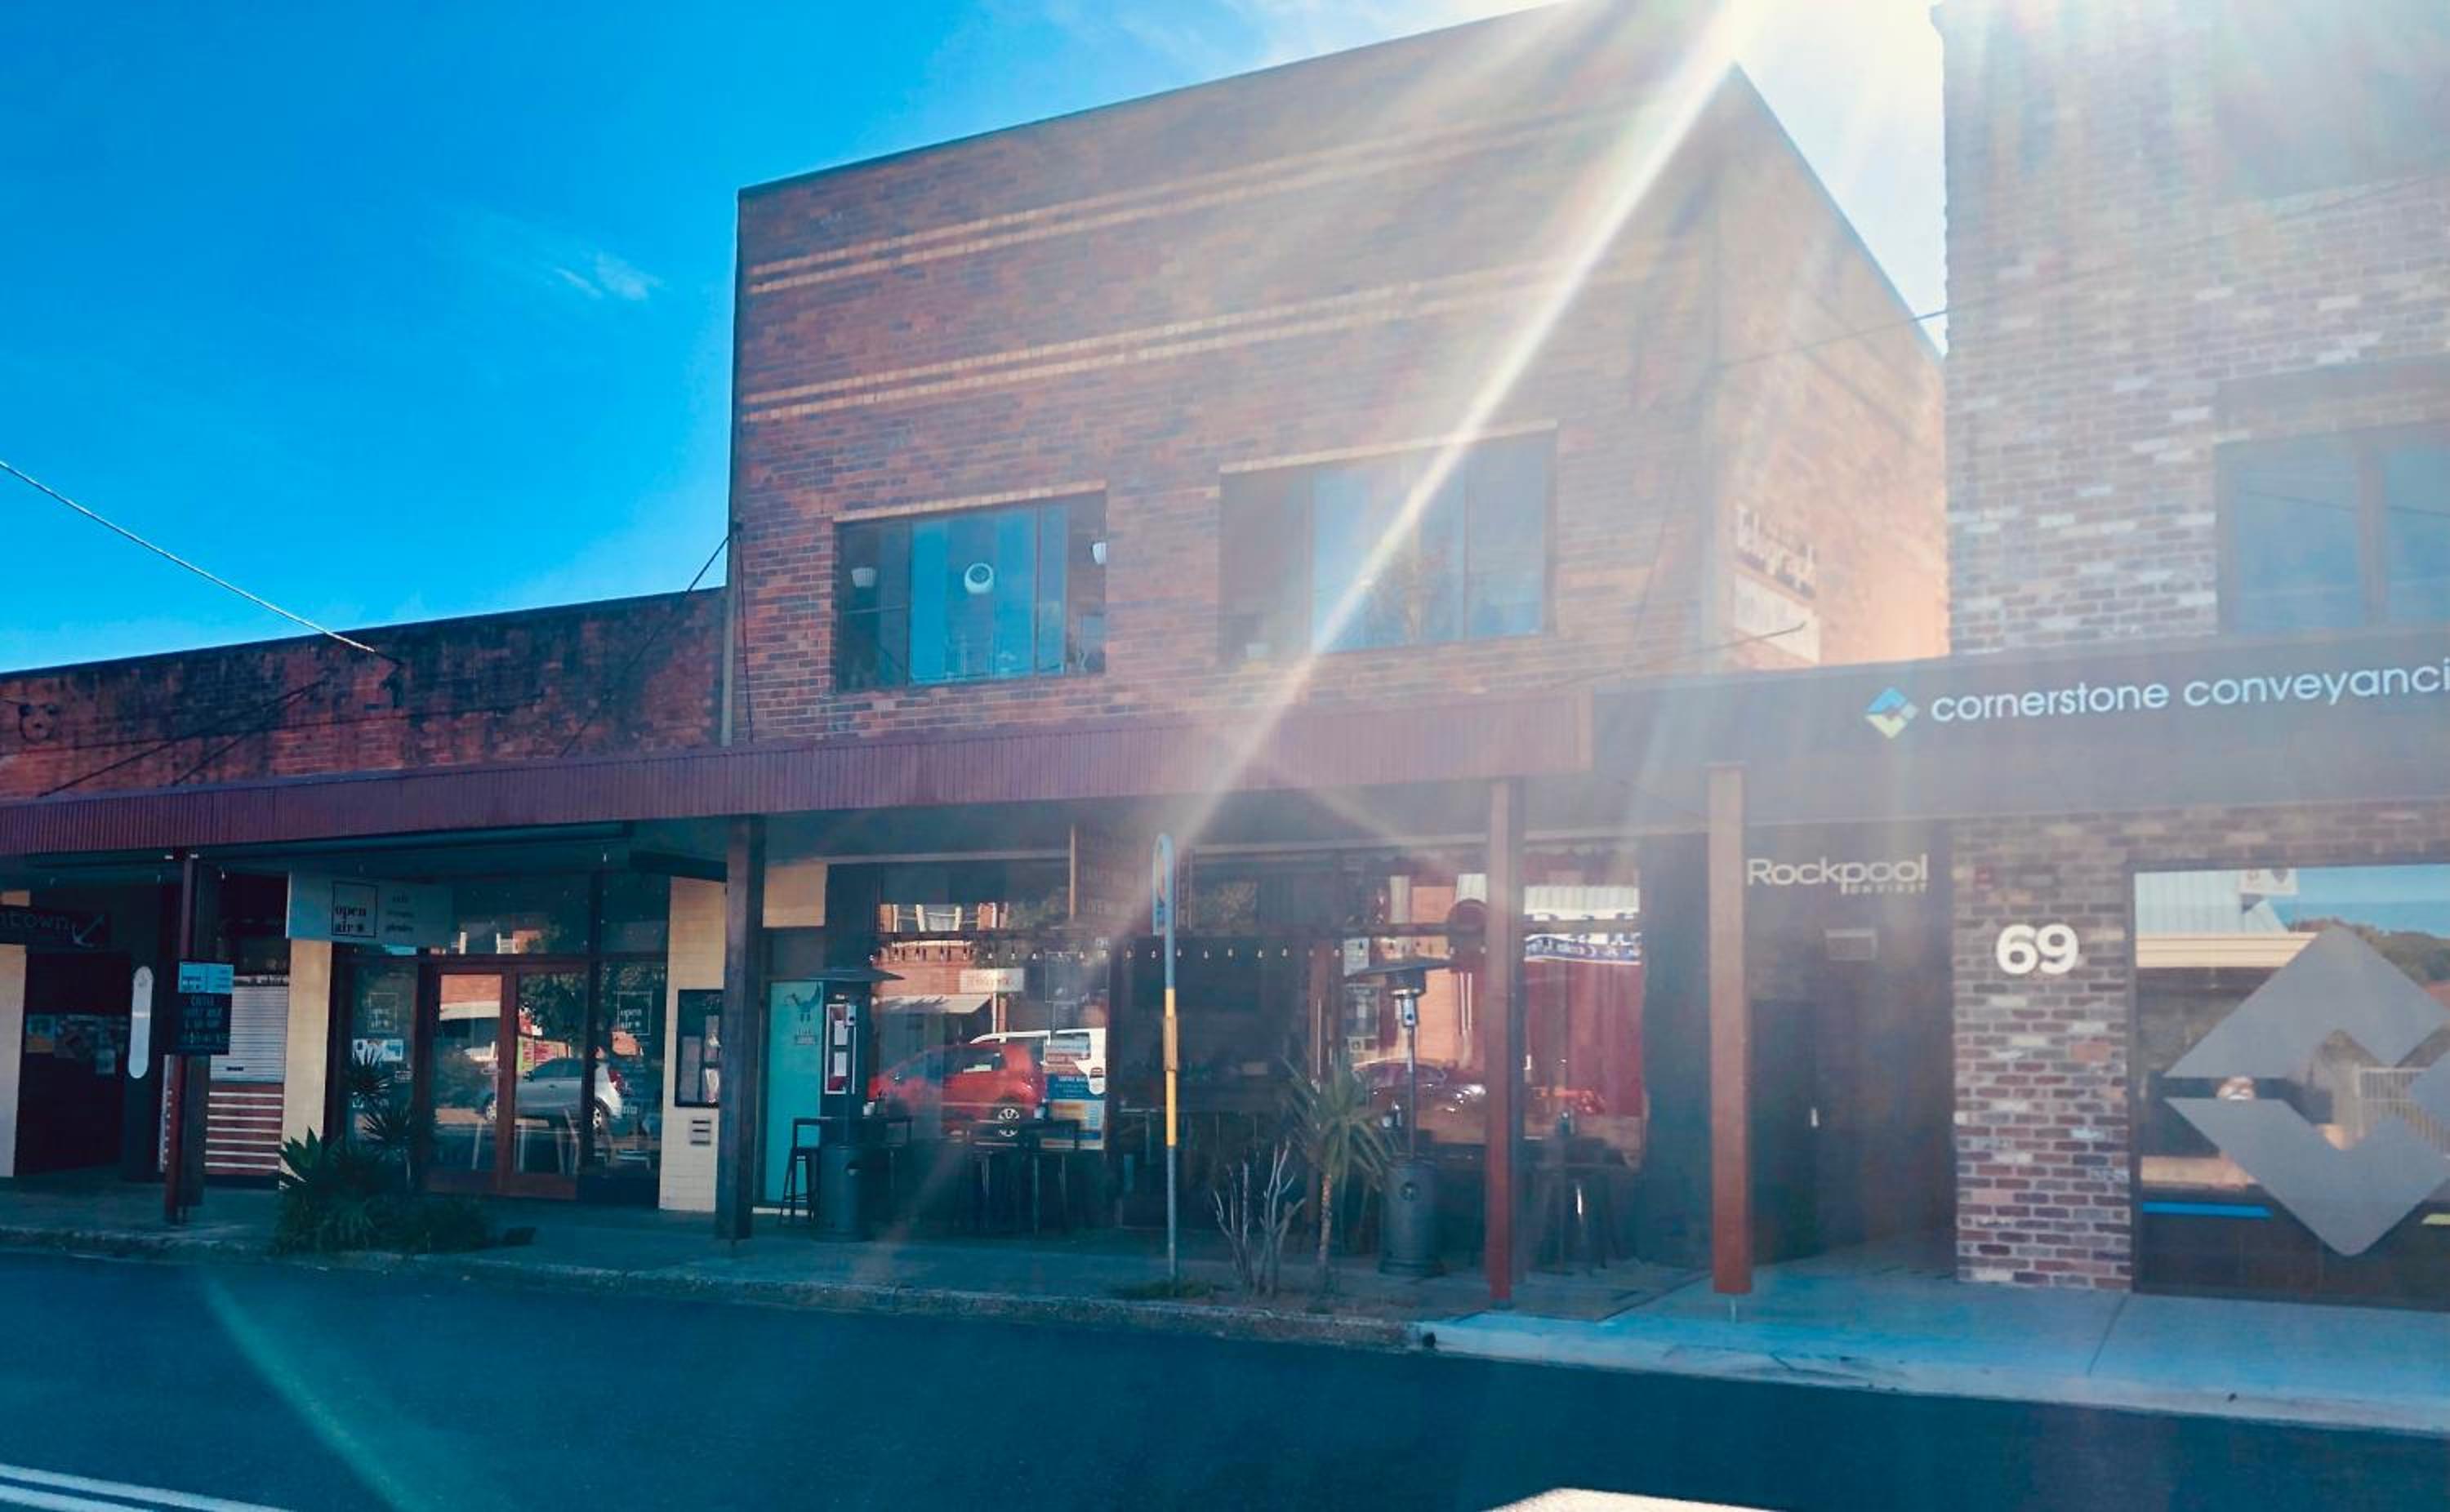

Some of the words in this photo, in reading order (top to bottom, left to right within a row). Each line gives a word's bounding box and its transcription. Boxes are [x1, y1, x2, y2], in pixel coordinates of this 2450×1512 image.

[1931, 681, 2171, 723] cornerstone
[1747, 854, 1929, 896] Rockpool
[335, 905, 367, 919] open
[335, 920, 354, 932] air
[1995, 923, 2079, 975] 69
